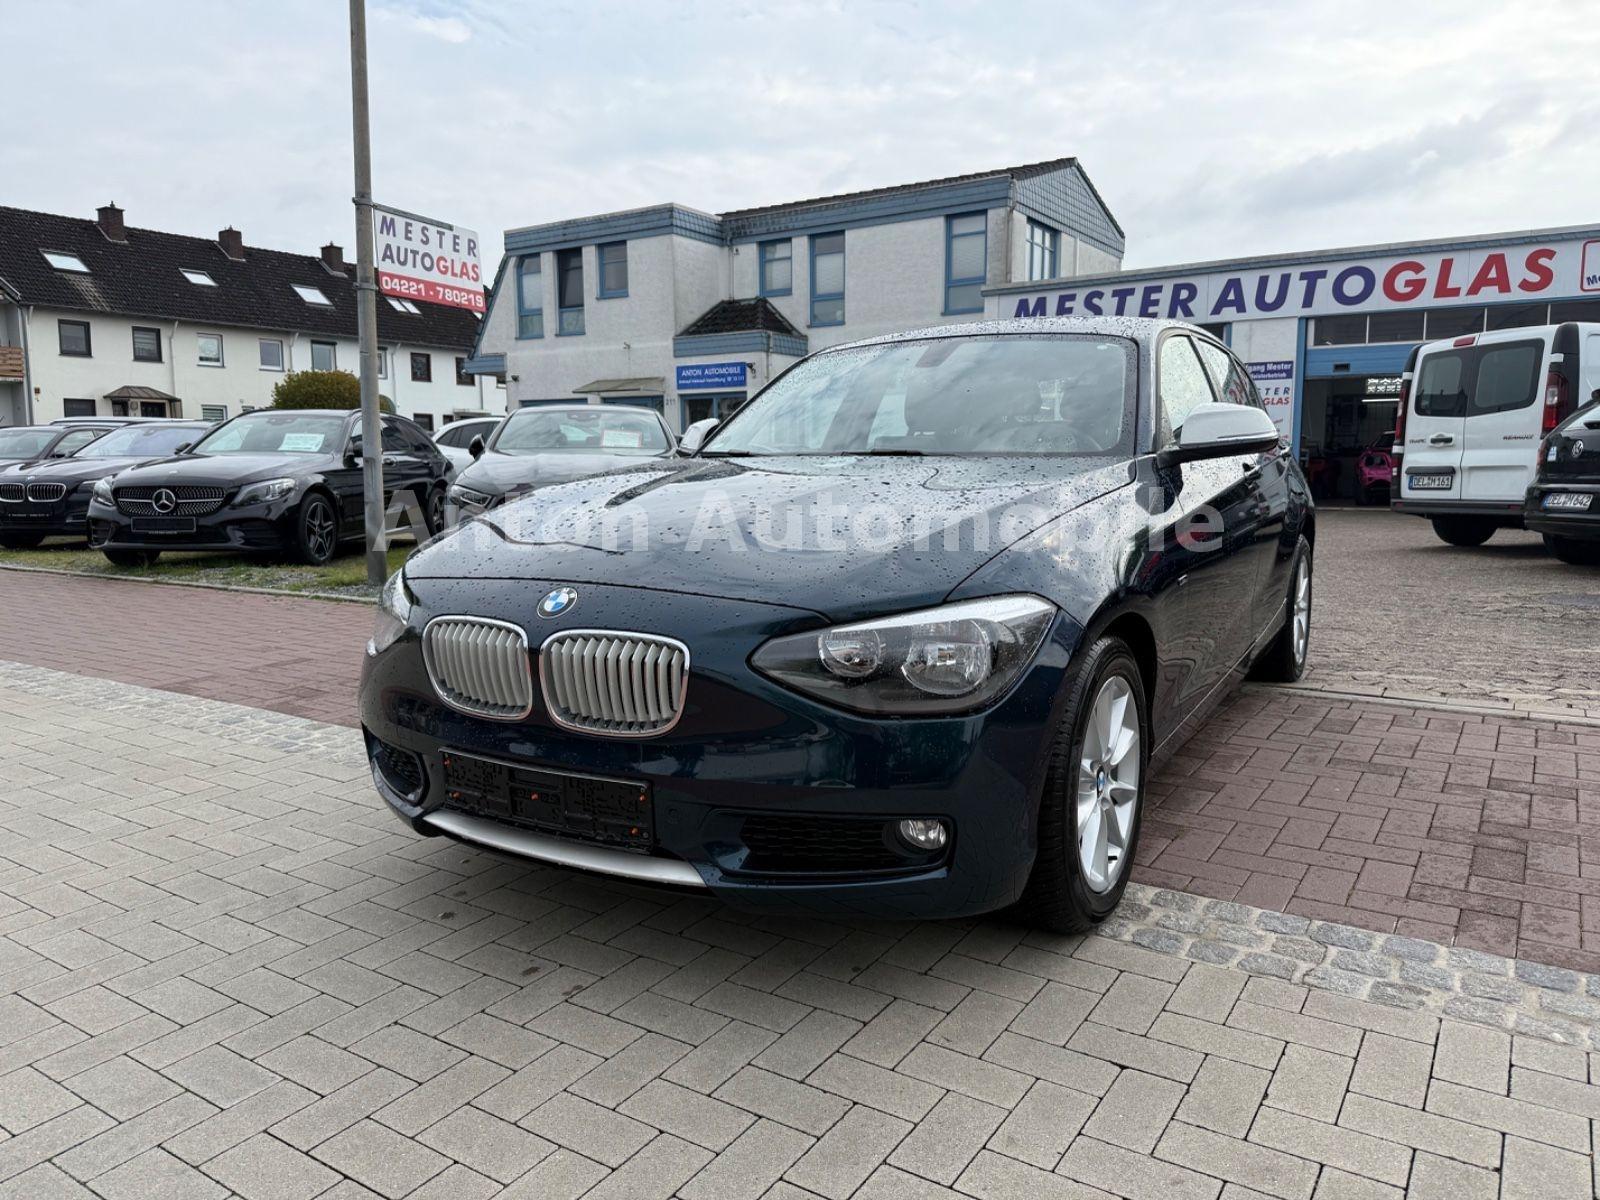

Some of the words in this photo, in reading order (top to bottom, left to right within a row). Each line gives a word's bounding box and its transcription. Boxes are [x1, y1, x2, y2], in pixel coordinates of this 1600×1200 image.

[379, 215, 477, 258] MESTER
[381, 243, 480, 283] AUTOGLAS
[1014, 282, 1198, 318] MESTER
[1209, 248, 1557, 316] AUTOGLAS
[382, 276, 426, 297] 04221
[435, 286, 484, 308] 780219
[1263, 397, 1290, 406] GLAS
